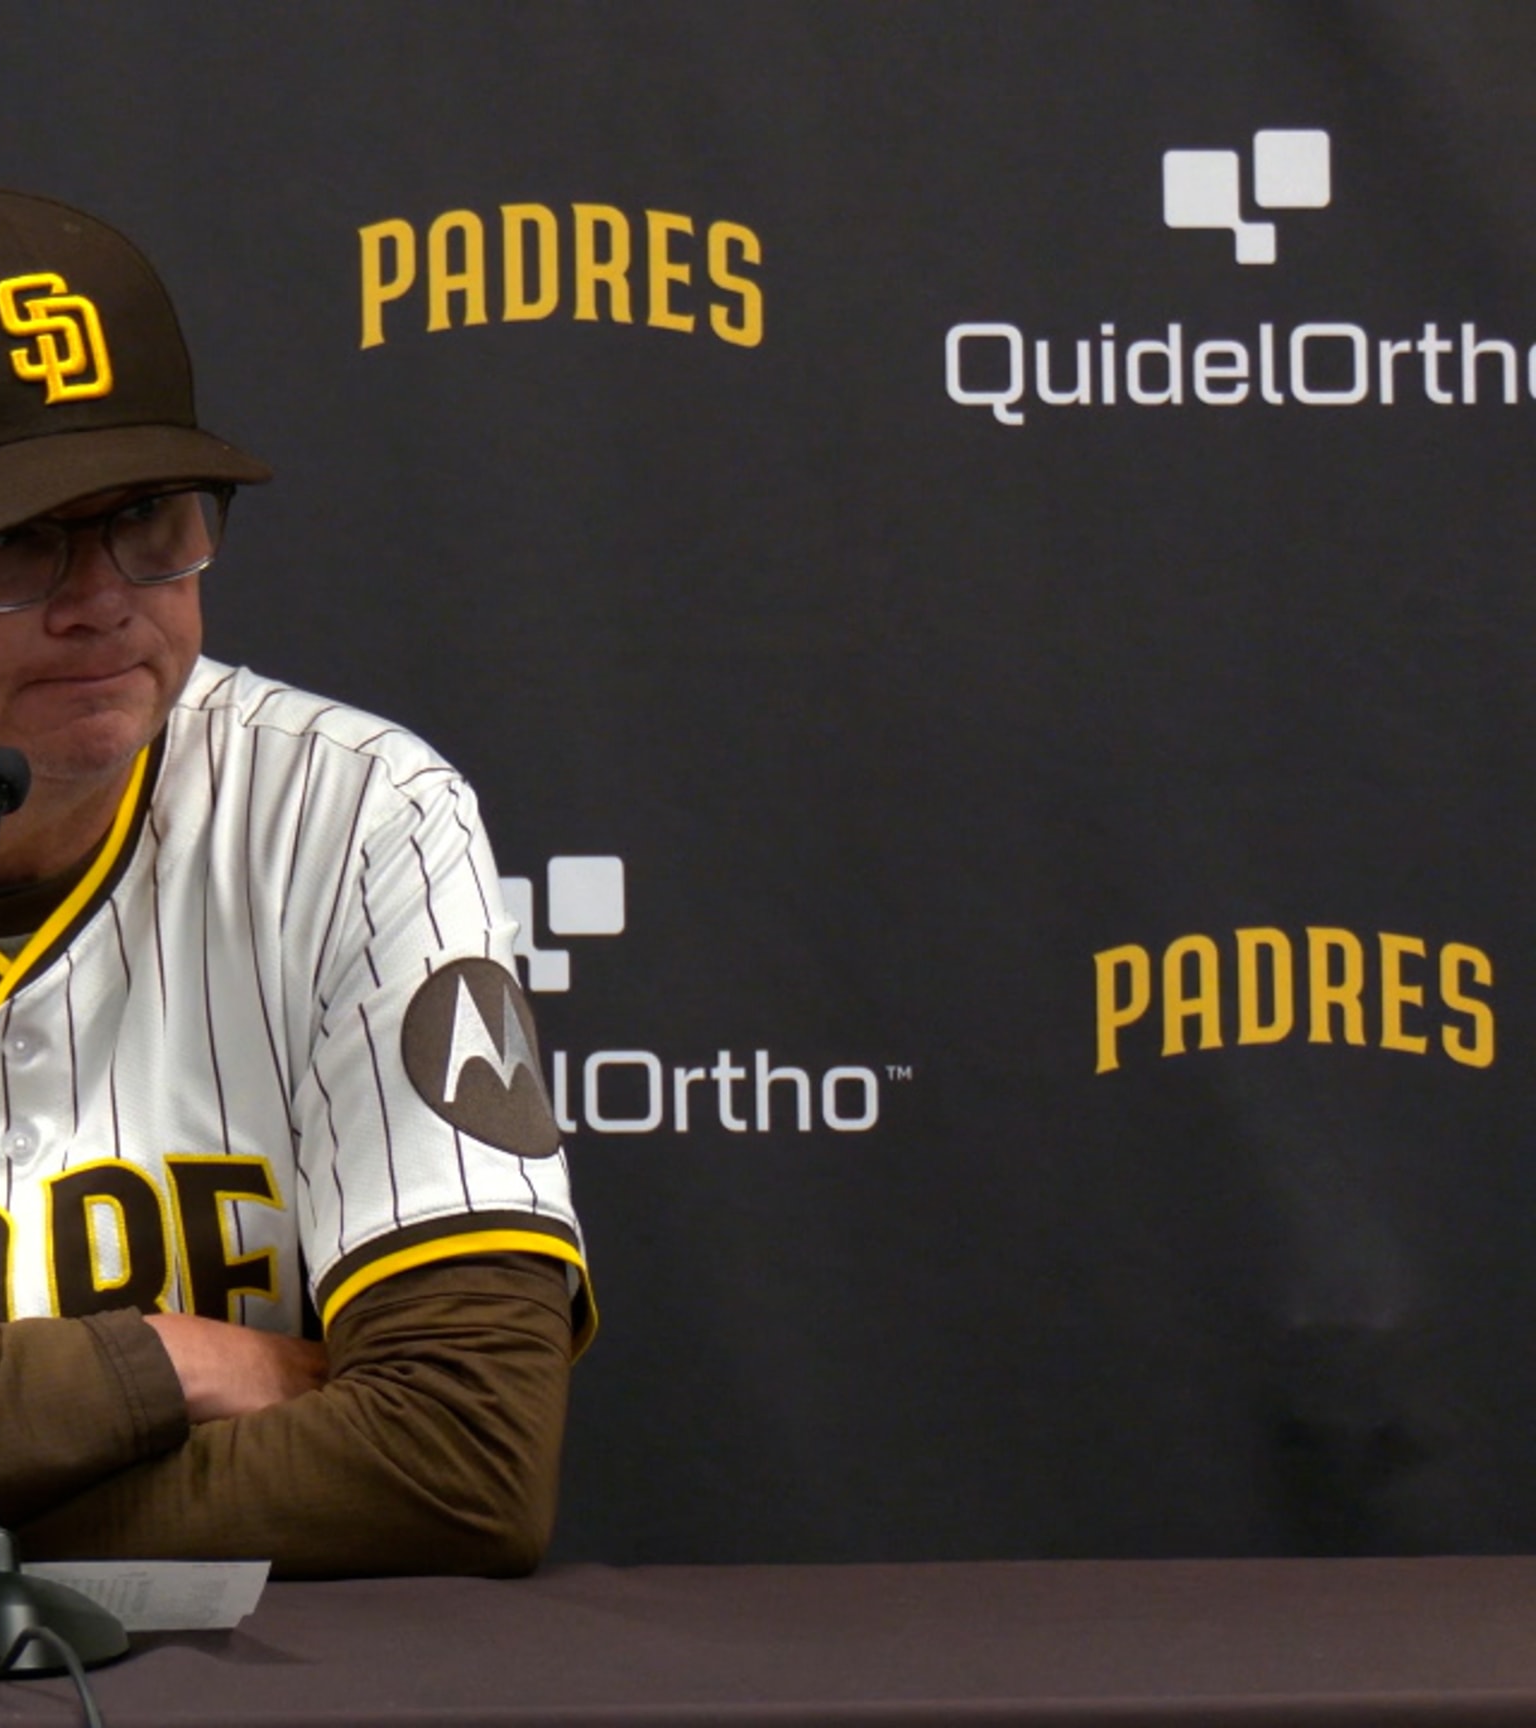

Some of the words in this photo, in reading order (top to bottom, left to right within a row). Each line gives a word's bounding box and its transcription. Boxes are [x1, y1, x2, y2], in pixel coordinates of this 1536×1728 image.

[357, 202, 765, 349] PADRES
[945, 322, 1536, 426] QuidelOrth
[1093, 925, 1497, 1074] PADRES
